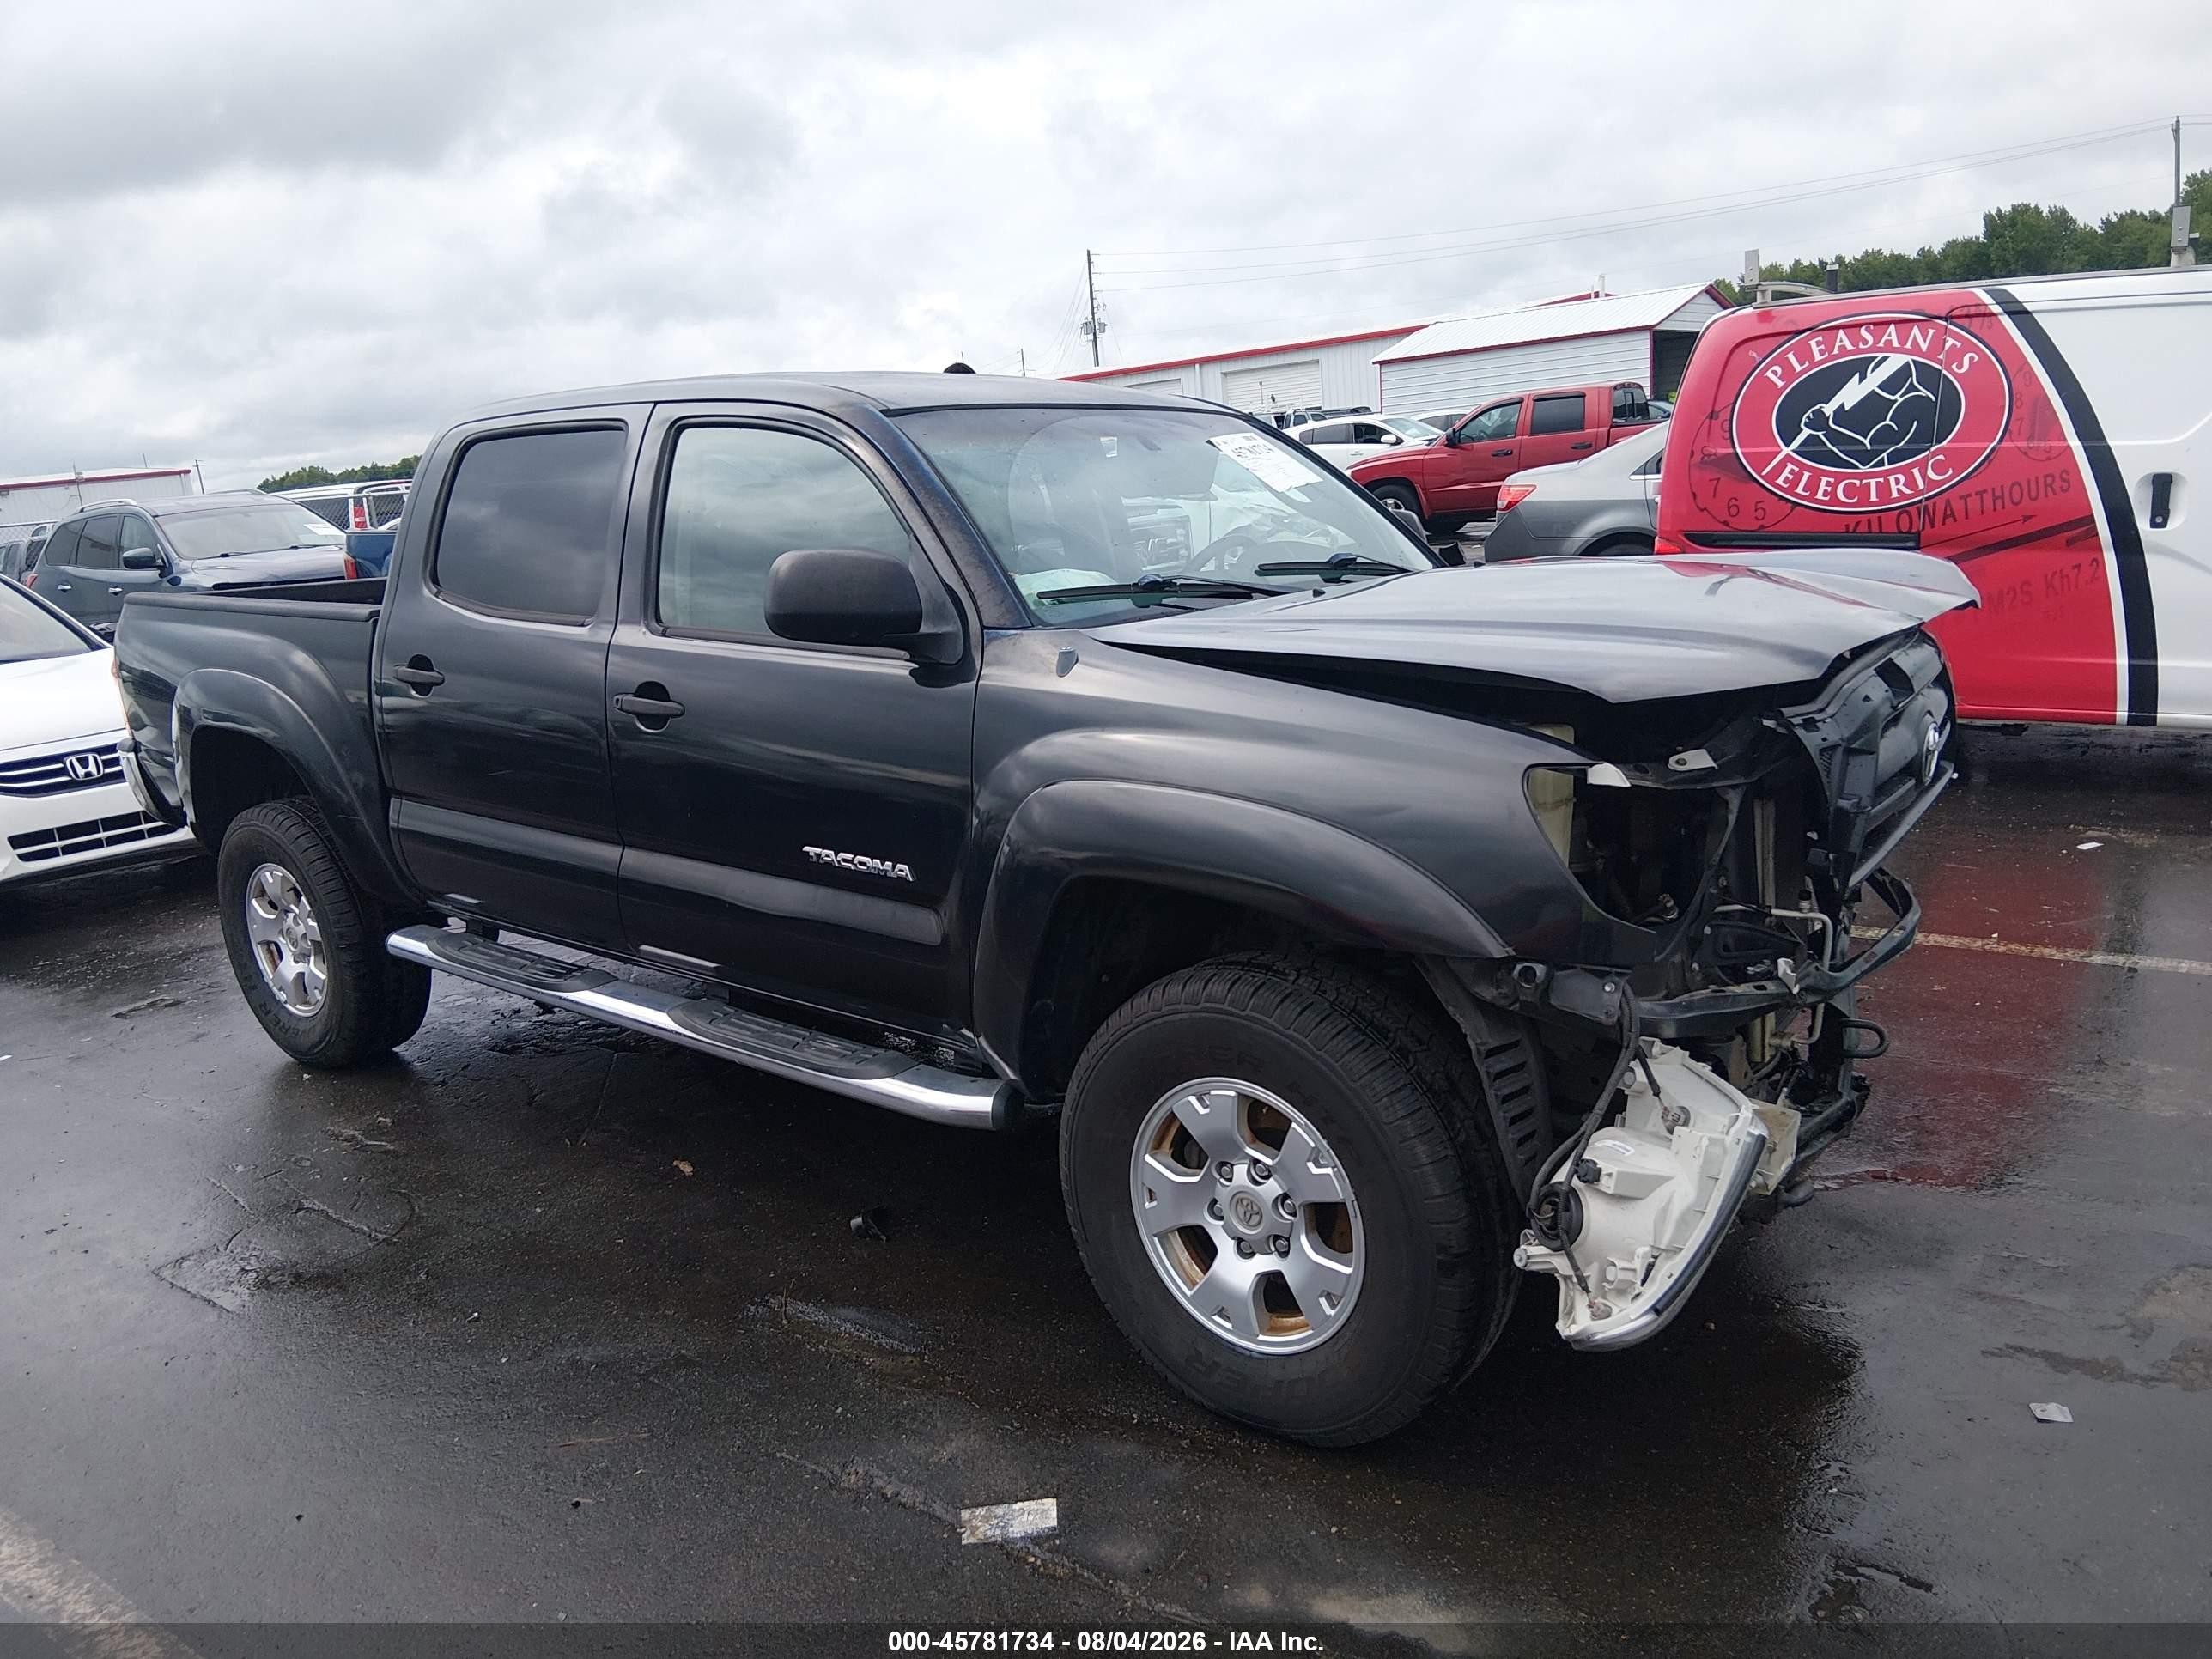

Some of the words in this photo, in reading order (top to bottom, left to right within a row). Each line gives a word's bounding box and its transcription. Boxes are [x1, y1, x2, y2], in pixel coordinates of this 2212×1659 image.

[1764, 323, 1979, 388] PLEASANTS
[1709, 477, 1721, 498] 7
[1776, 454, 1954, 503] ELECTRIC
[1727, 496, 1740, 518] 6
[1754, 500, 1766, 521] 5
[802, 846, 916, 882] TACOMA
